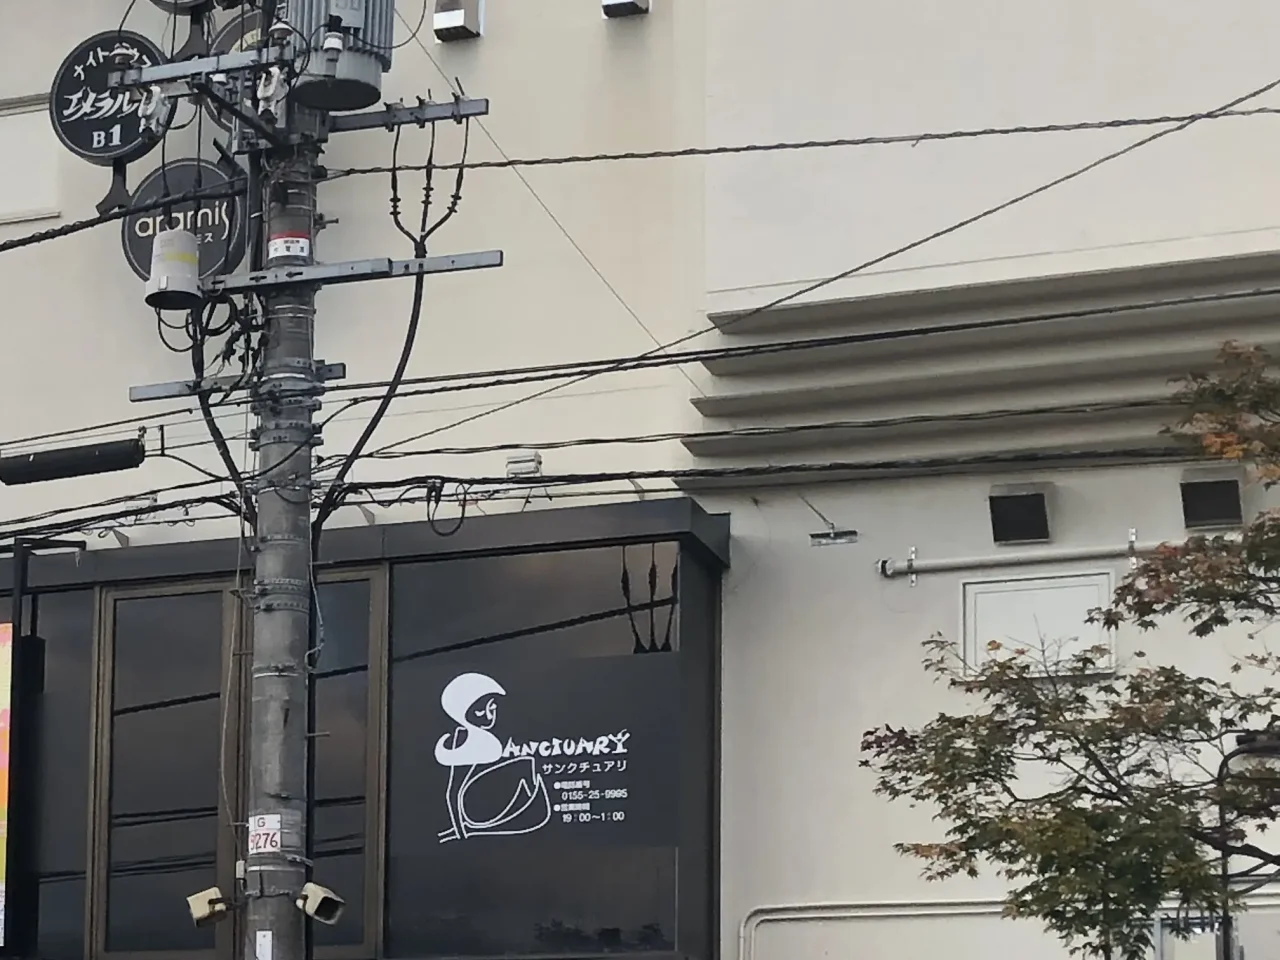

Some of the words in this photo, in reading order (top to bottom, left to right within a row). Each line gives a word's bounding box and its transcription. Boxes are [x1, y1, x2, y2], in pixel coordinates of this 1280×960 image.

[61, 86, 141, 122] エメラル
[92, 123, 122, 148] B1
[541, 759, 628, 775] サンクチュアリ
[256, 816, 266, 828] G
